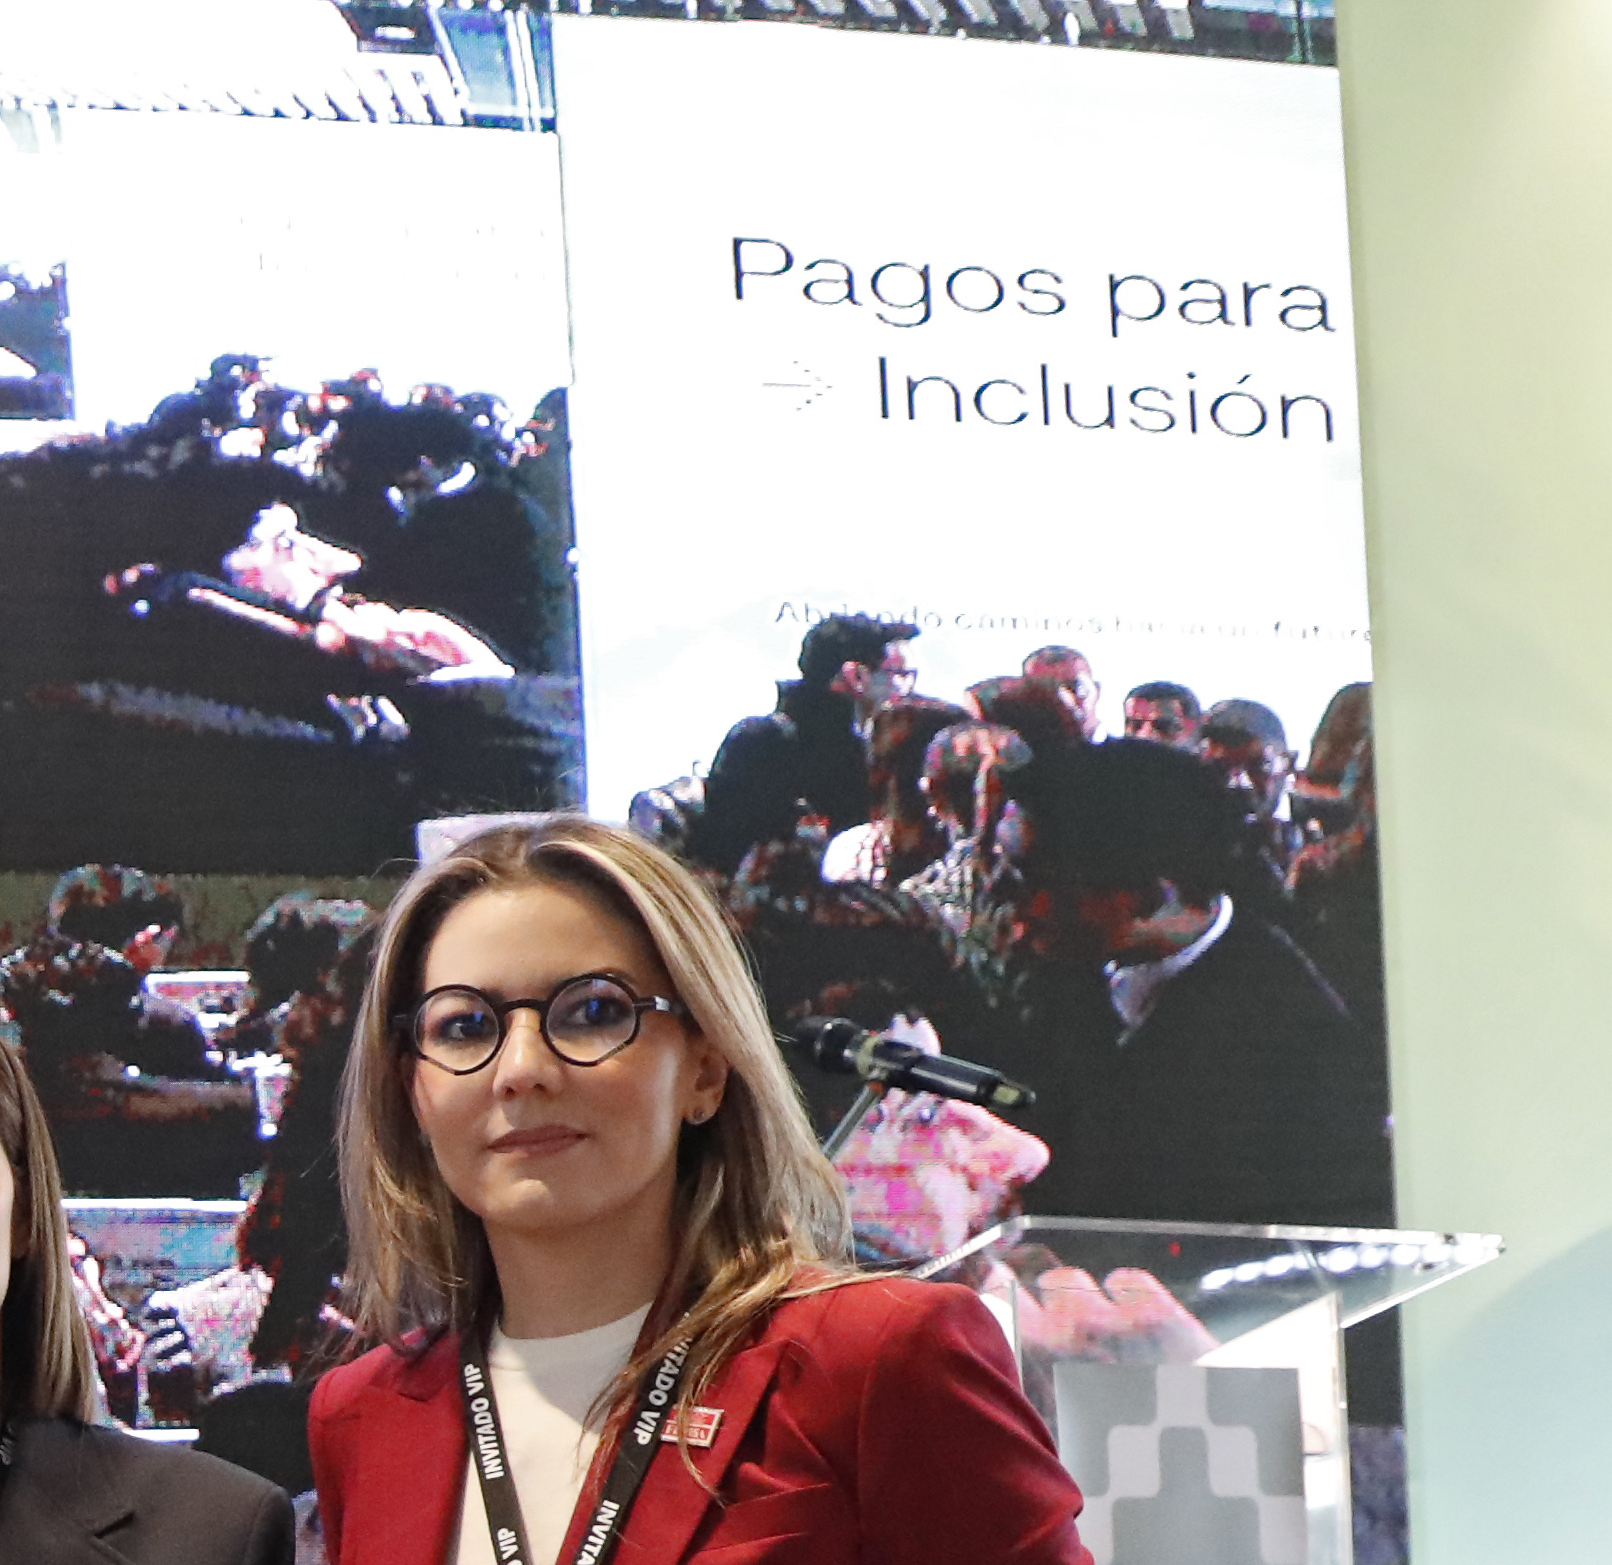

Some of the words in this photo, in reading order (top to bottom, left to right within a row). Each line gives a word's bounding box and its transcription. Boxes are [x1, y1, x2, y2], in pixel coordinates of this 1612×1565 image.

[732, 236, 1067, 327] Pagos
[1108, 269, 1337, 338] para
[877, 356, 1335, 443] Inclusión
[464, 1363, 485, 1395] VIP
[470, 1396, 505, 1479] INVITADO
[636, 1410, 666, 1446] VIP
[497, 1527, 518, 1559] VIP
